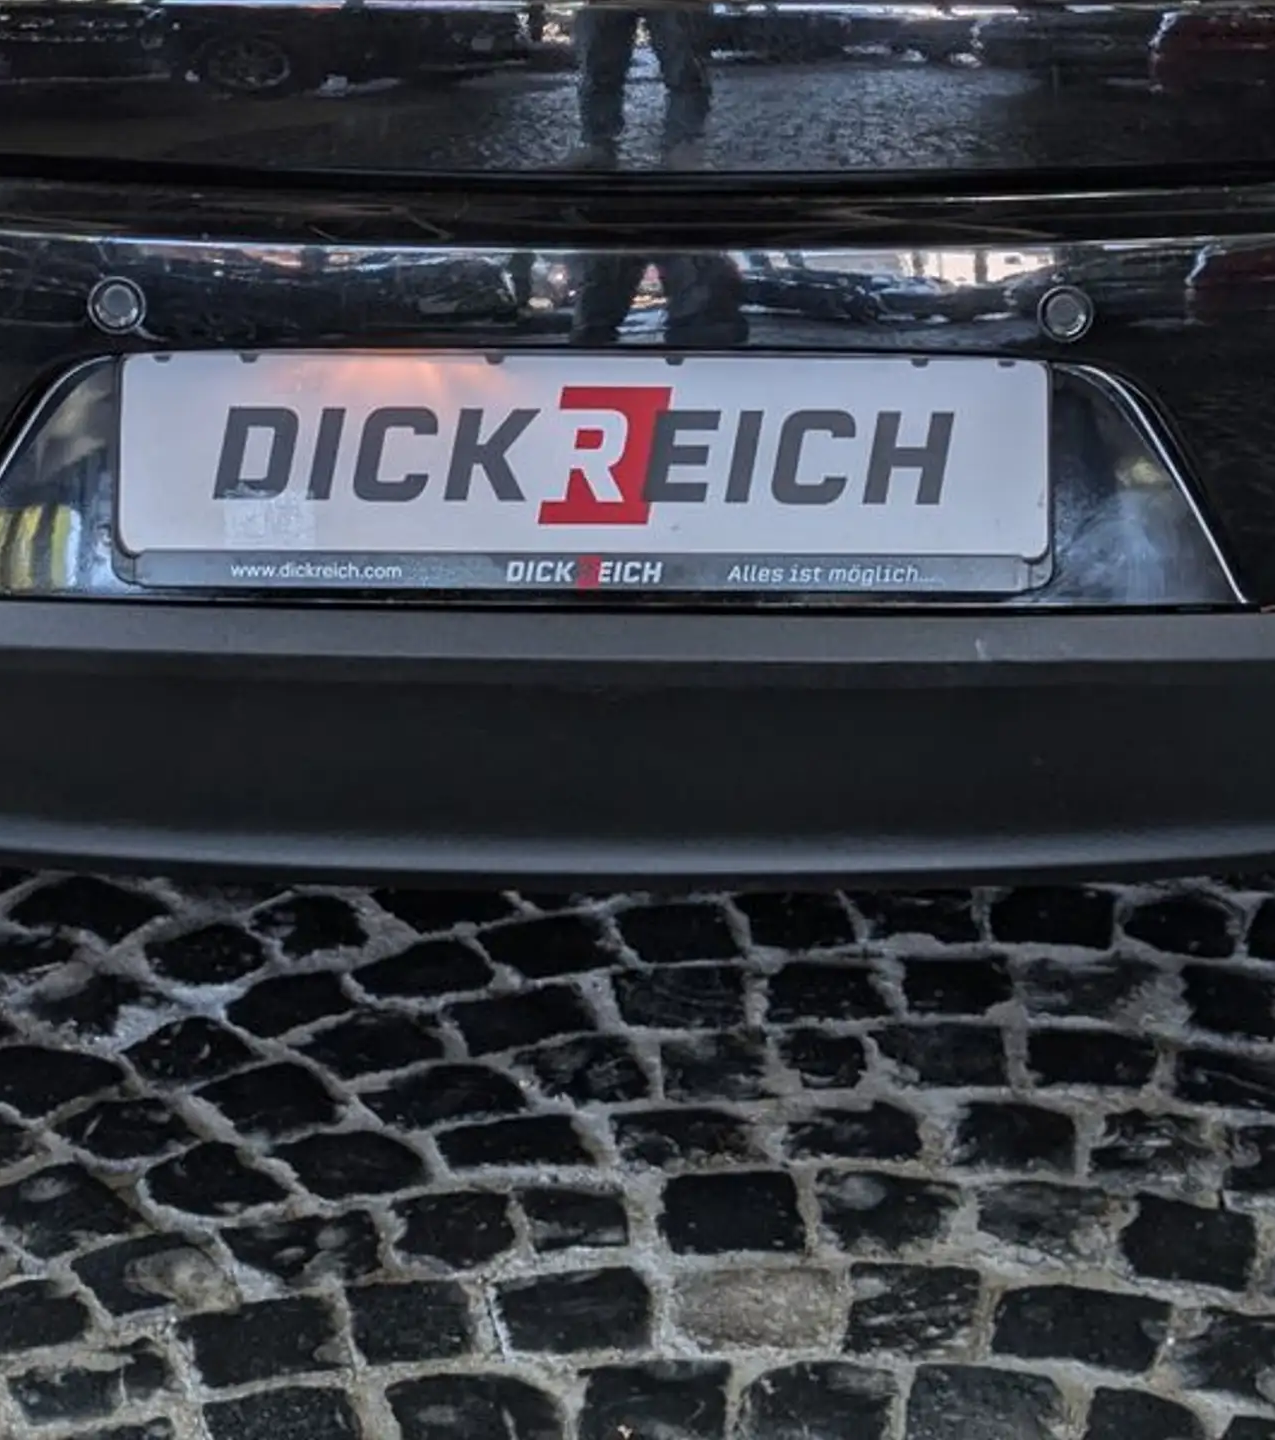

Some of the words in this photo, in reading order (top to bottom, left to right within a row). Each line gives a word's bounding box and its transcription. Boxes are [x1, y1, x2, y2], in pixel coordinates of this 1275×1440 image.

[212, 406, 955, 506] DICKREICH
[230, 561, 403, 579] www.dickreich.com
[506, 560, 663, 583] DICKEICH
[728, 563, 783, 582] Alles
[789, 563, 821, 582] ist
